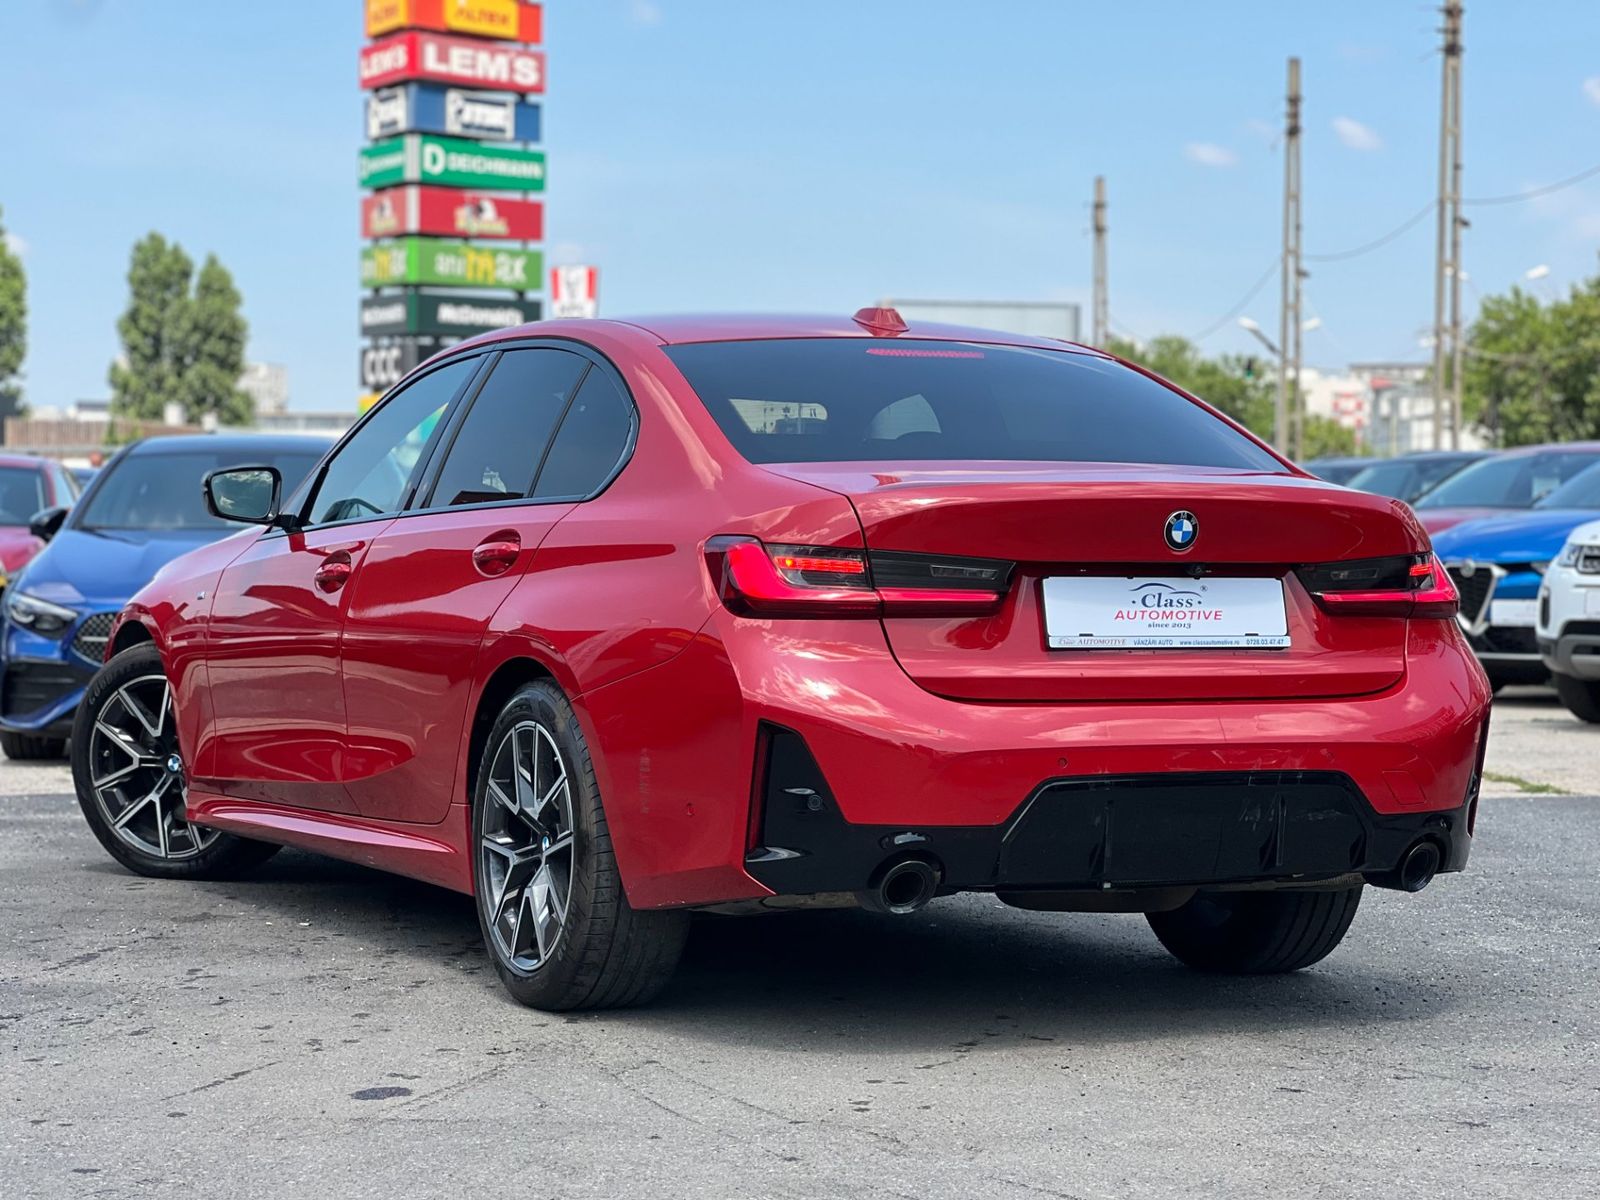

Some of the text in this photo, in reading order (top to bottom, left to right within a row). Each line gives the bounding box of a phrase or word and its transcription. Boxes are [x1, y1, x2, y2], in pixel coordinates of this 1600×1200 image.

[1141, 592, 1194, 608] Class
[1114, 610, 1223, 620] AUTOMOTIVE
[1171, 622, 1192, 630] 2013
